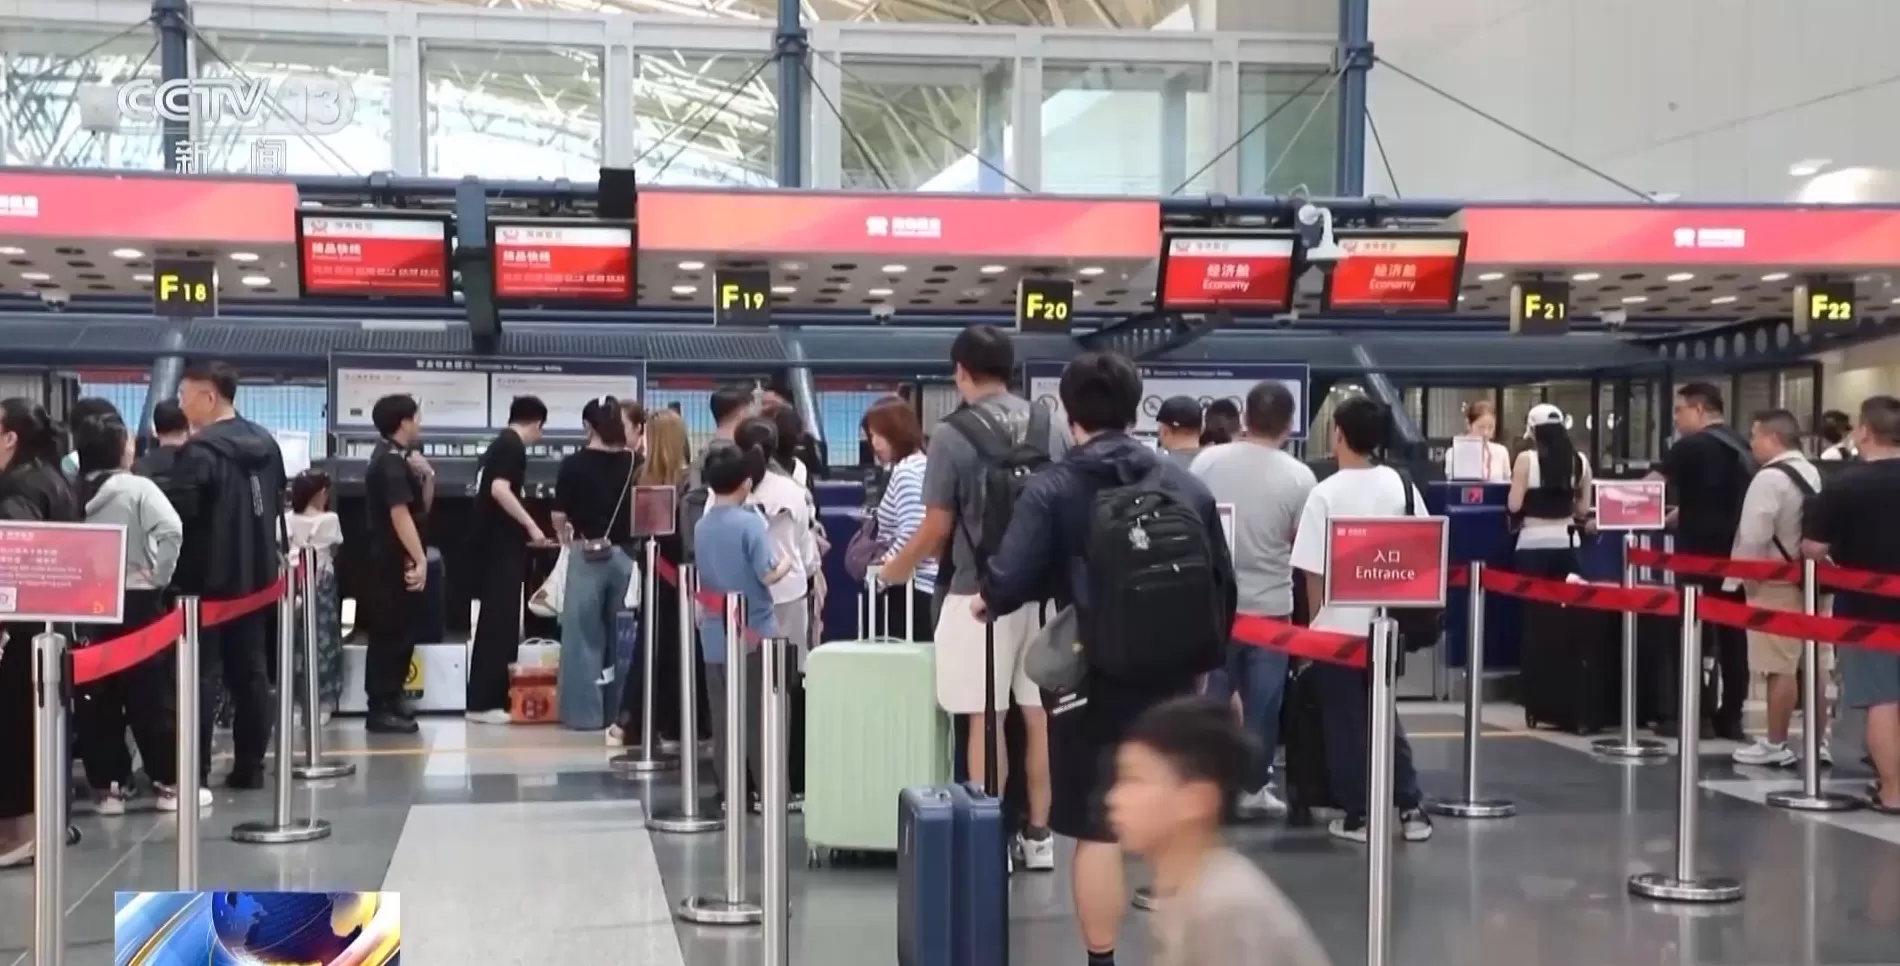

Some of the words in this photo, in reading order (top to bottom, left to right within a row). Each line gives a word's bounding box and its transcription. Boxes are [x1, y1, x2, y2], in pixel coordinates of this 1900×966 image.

[160, 274, 207, 302] F18
[722, 284, 765, 308] F19
[1202, 279, 1250, 293] Economy
[1368, 279, 1416, 293] Economy
[1026, 293, 1069, 320] F20
[1525, 294, 1566, 320] F21
[1811, 294, 1853, 320] F22
[1373, 550, 1400, 563] 入口
[1355, 566, 1415, 580] Entrance
